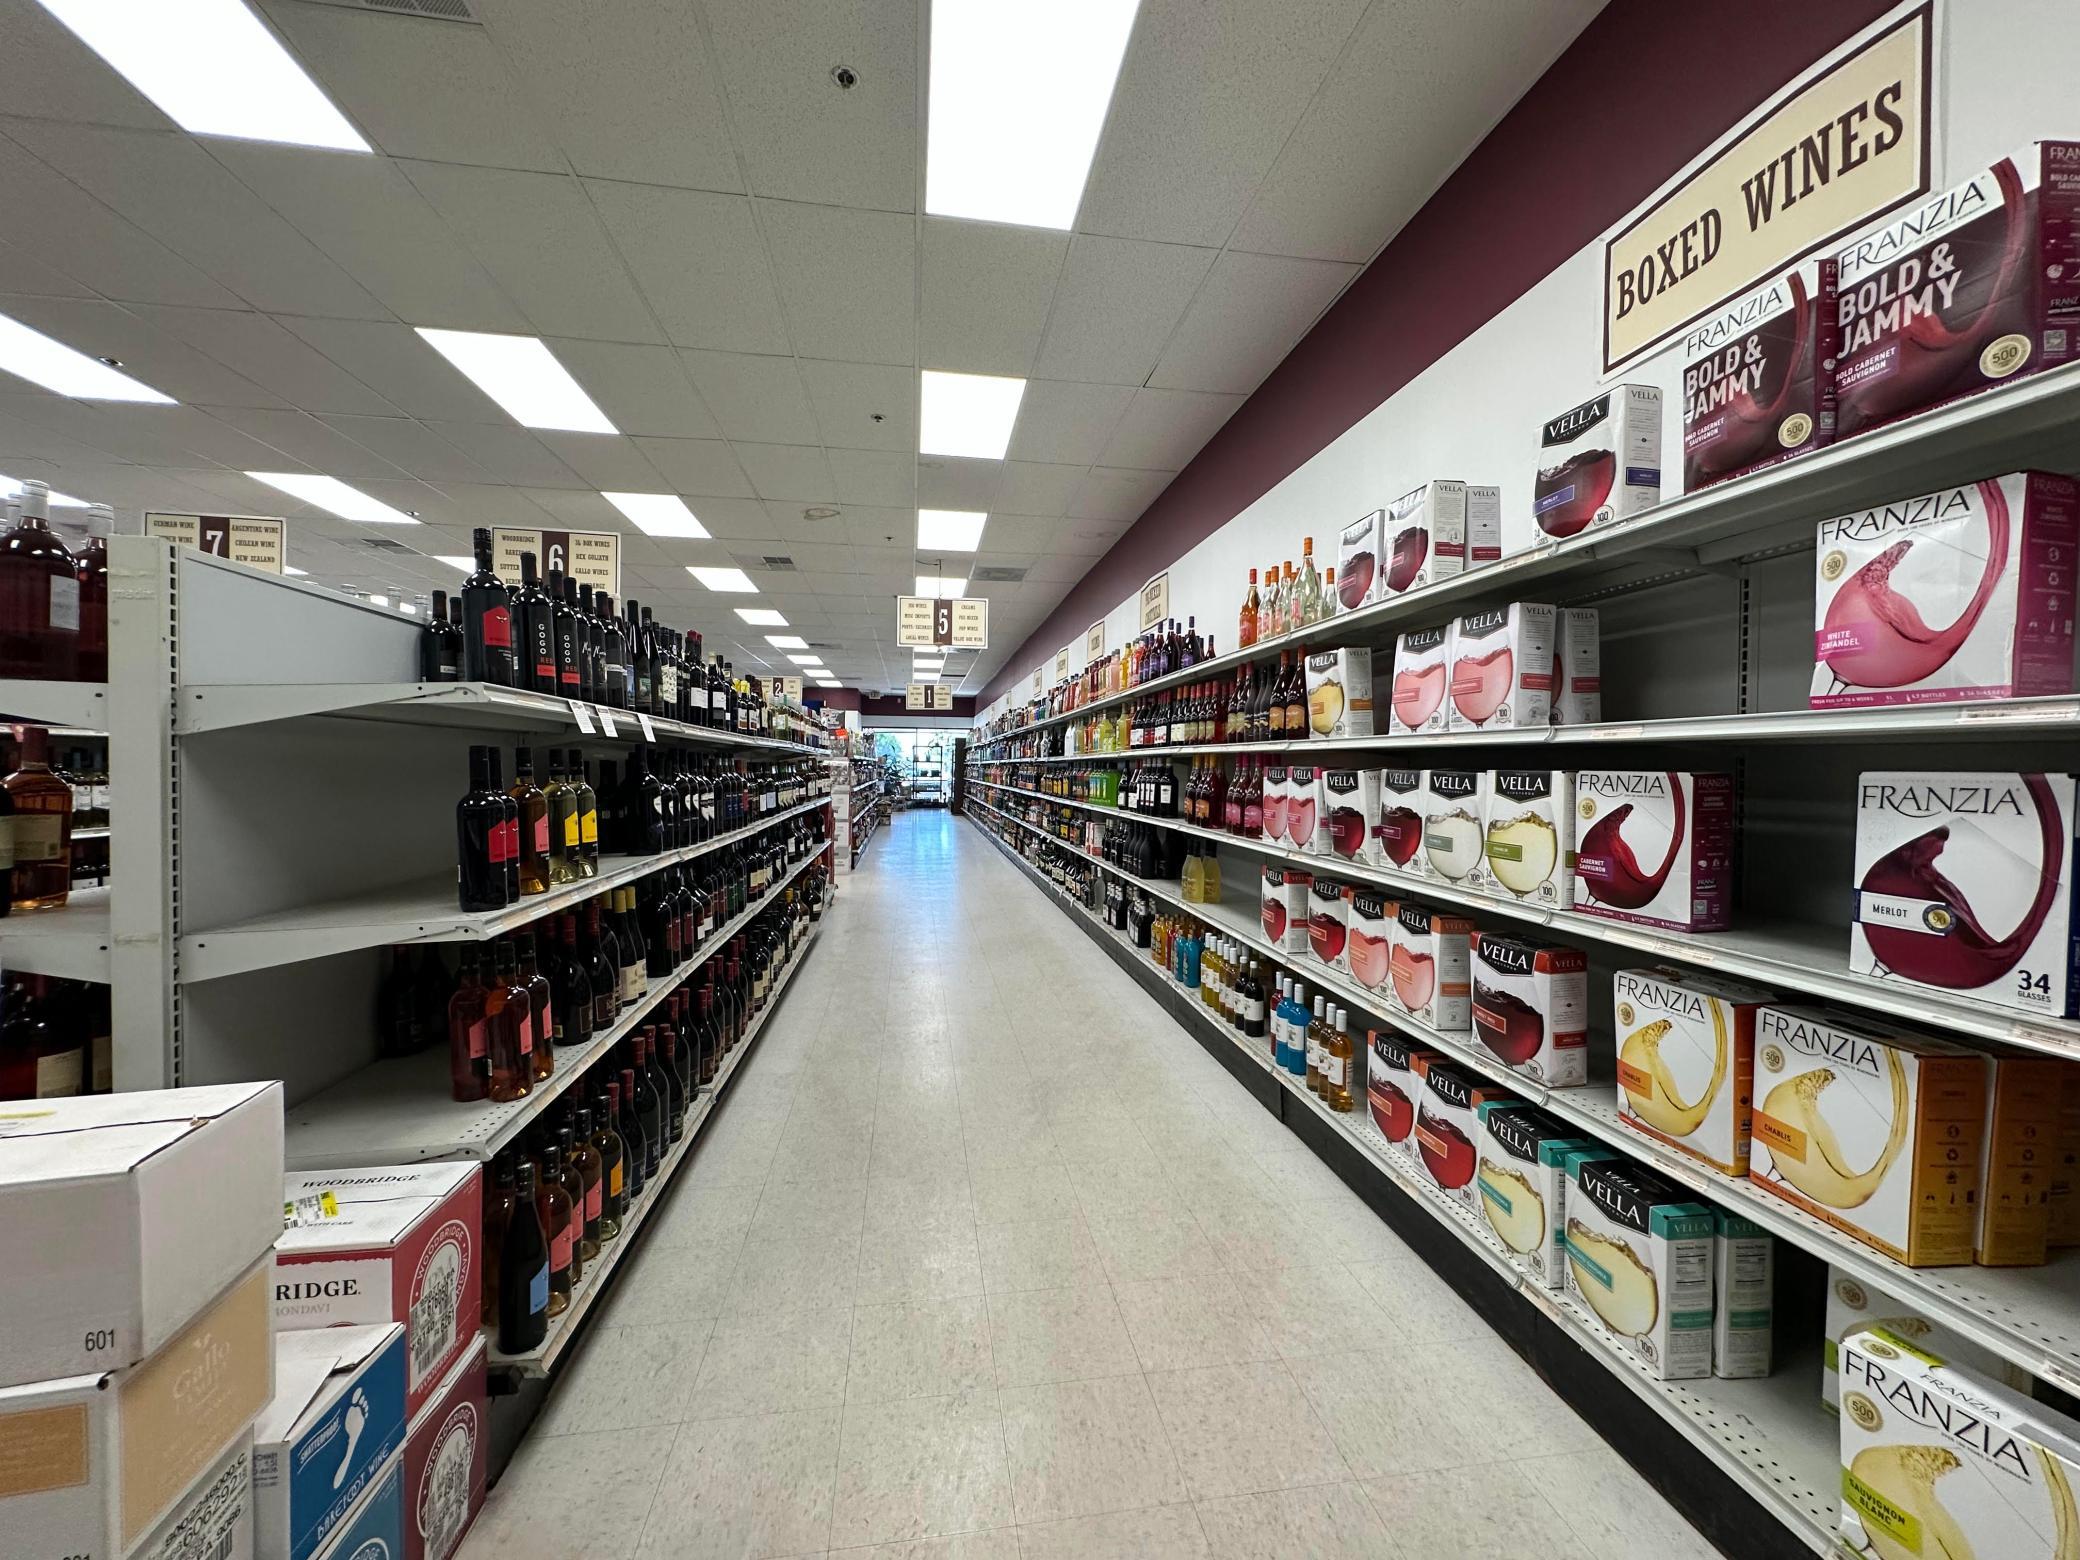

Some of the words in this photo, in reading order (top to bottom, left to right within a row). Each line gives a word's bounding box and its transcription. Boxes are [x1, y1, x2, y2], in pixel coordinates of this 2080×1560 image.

[1615, 208, 1722, 321] BOXED
[1741, 80, 1904, 233] WINES
[1840, 181, 1986, 279] FRANZIA
[1837, 258, 1921, 328] BOLD
[1928, 242, 1956, 280] &
[1837, 269, 1963, 360] JAMMY
[1687, 287, 1783, 358] FRANZIA
[1991, 346, 2018, 364] 500
[1685, 346, 1741, 398] BOLD
[1745, 334, 1762, 360] &
[1835, 366, 1853, 383] BOLD
[1854, 347, 1896, 373] CABERNET
[1841, 360, 1887, 386] SAUVIGNON
[1631, 389, 1659, 401] VELLA
[1684, 358, 1767, 425] JAMMY
[1549, 403, 1601, 438] VELLA
[1786, 422, 1804, 436] 500
[1439, 484, 1463, 493] VELLA
[2033, 478, 2075, 493] FRANZIA
[1597, 510, 1609, 522] 100
[1821, 490, 1971, 545] FRANZIA
[153, 520, 177, 528] GERMAN
[179, 521, 195, 529] WINE
[231, 524, 263, 533] ARGENTINE
[264, 526, 279, 534] WINE
[178, 536, 193, 544] WINE
[206, 530, 223, 557] 7
[235, 539, 259, 548] CHILEAN
[501, 534, 535, 543] WOODBRIDGE
[235, 554, 248, 562] NEW
[250, 555, 276, 563] ZEALAND
[548, 544, 564, 571] 6
[588, 554, 609, 562] GOLIATH
[1826, 559, 1841, 570] 500
[1526, 606, 1553, 616] VELLA
[1571, 611, 1595, 620] VELLA
[938, 608, 949, 635] 5
[1465, 611, 1503, 631] VELLA
[1407, 631, 1441, 647] VELLA
[1827, 630, 1851, 641] WHITE
[1821, 638, 1860, 651] ZINFANDEL
[1310, 654, 1335, 668] VELLA
[1350, 650, 1369, 658] VELLA
[774, 682, 782, 697] 2
[927, 689, 932, 703] 1
[1431, 716, 1439, 724] 100
[1498, 708, 1508, 718] 100
[1268, 769, 1285, 779] VELLA
[1293, 770, 1312, 780] VELLA
[1329, 776, 1355, 787] VELLA
[1388, 773, 1416, 785] VELLA
[1433, 775, 1472, 790] VELLA
[1500, 776, 1545, 791] VELLA
[1579, 774, 1665, 797] FRANZIA
[1581, 804, 1593, 813] 500
[1861, 785, 2024, 818] FRANZIA
[1579, 863, 1606, 873] SAUVIGNON
[1580, 857, 1605, 866] CABERNET
[1266, 870, 1282, 882] VELLA
[1470, 874, 1481, 882] 100
[1315, 882, 1338, 897] VELLA
[1542, 886, 1553, 895] 100
[1355, 896, 1382, 916] VELLA
[1872, 903, 1908, 918] MERLOT
[1400, 908, 1429, 930] VELLA
[1932, 914, 1947, 926] 90
[1482, 942, 1529, 970] VELLA
[1555, 959, 1583, 968] VELLA
[2017, 970, 2051, 994] 34
[1617, 975, 1705, 1019] FRANZIA
[2017, 990, 2051, 1003] GLASSES
[1762, 1011, 1879, 1072] FRANZIA
[1376, 1040, 1407, 1066] VELLA
[1766, 1052, 1781, 1065] 500
[1430, 1072, 1467, 1105] VELLA
[1508, 1114, 1535, 1132] VELLA
[1491, 1116, 1533, 1158] VELLA
[1764, 1124, 1793, 1143] CHABLIS
[302, 1174, 422, 1188] WOODBRIDGE
[1605, 1170, 1640, 1194] VELLA
[1583, 1172, 1642, 1226] VELLA
[1674, 1223, 1710, 1232] VELLA
[417, 1226, 465, 1279] WOODBRIDGE
[84, 1329, 116, 1351] 601
[1919, 1373, 2001, 1421] FRANZIA
[1845, 1349, 2030, 1477] FRANZIA
[1852, 1400, 1874, 1422] 500
[300, 1416, 341, 1465] SHATTERPROOF
[426, 1408, 472, 1478] WOODBRIDGE
[317, 1474, 365, 1541] BAREFOOT
[368, 1442, 390, 1476] WINE
[1848, 1477, 1906, 1526] SAUVIGNON
[1858, 1495, 1892, 1526] BLANC
